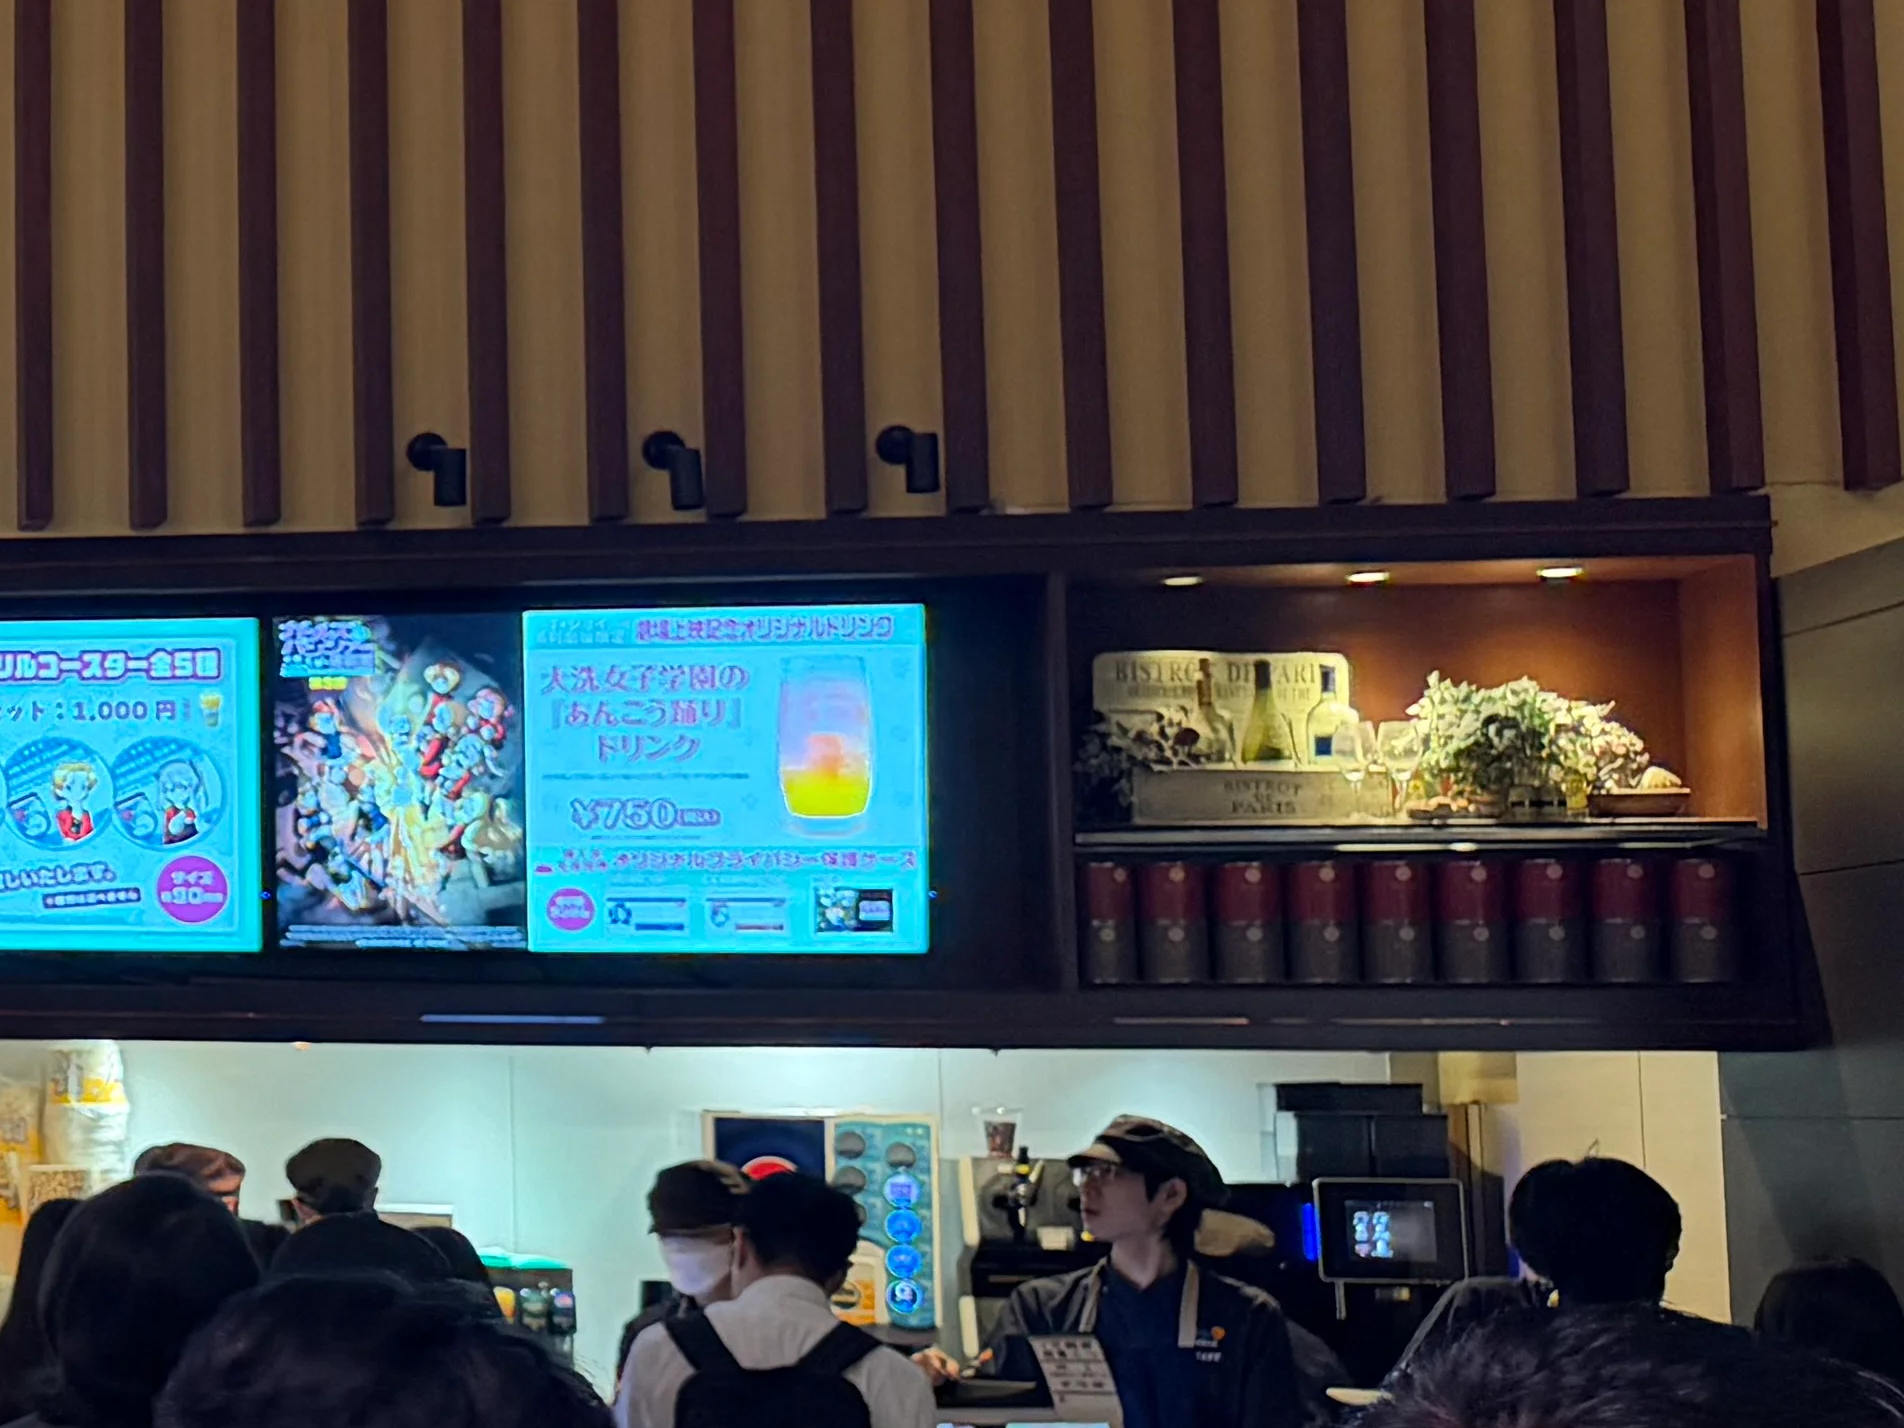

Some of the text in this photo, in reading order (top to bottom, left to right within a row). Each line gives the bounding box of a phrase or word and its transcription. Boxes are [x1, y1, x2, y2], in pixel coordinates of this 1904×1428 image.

[541, 664, 749, 695] 大洗女子学園の
[1115, 660, 1214, 684] BISTRO
[597, 733, 702, 764] ドリンク
[570, 797, 678, 830] ¥750
[1231, 801, 1296, 815] PARIS
